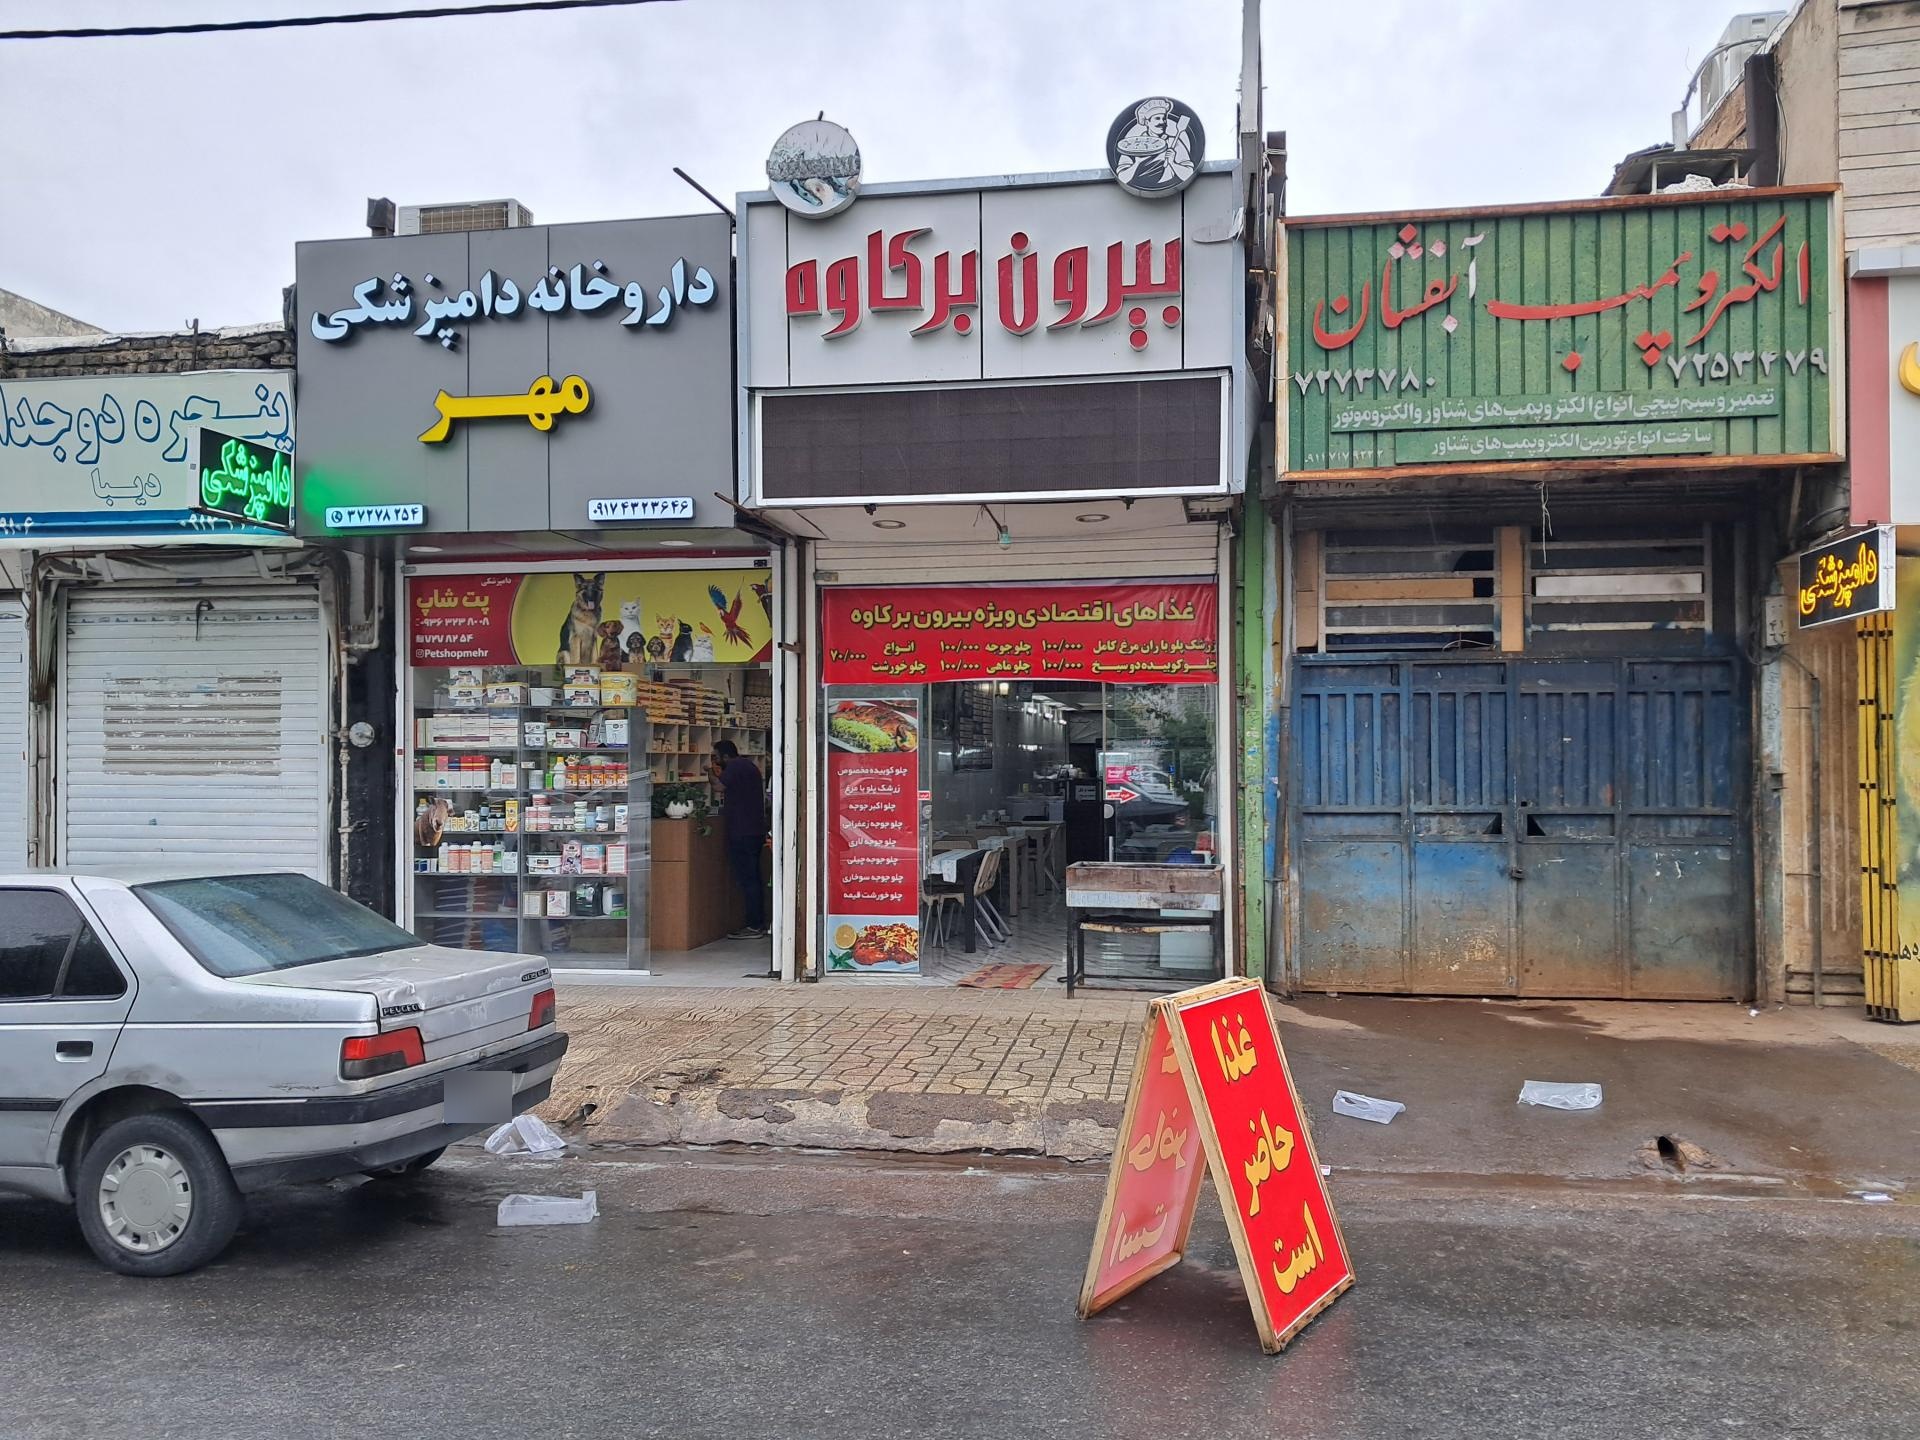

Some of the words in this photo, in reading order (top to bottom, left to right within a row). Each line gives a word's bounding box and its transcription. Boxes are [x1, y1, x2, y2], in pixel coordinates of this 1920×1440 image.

[529, 257, 718, 327] داروخانه
[997, 231, 1182, 351] بیرون
[311, 269, 526, 352] دامپزشکی
[1666, 347, 1829, 380] ۷۲۵۳۴۷۹
[1294, 366, 1436, 396] ۷۲۷۳۷۸۰
[417, 375, 593, 443] مهر
[1424, 398, 1467, 424] شناور
[1594, 394, 1633, 418] انواع
[1729, 388, 1775, 412] تعمیر
[1432, 435, 1470, 455] شناور
[1581, 431, 1627, 452] توربین
[1628, 430, 1661, 452] انواع
[1663, 426, 1711, 443] ساخت
[91, 467, 162, 506] دیبا
[416, 588, 459, 617] شاپ
[462, 591, 490, 615] پت
[1018, 600, 1112, 628] اقتصادی
[1114, 597, 1195, 627] غذاهای
[850, 605, 892, 629] کاوه
[913, 608, 972, 630] بیرون
[974, 602, 1016, 629] ویژه
[424, 648, 489, 660] Petshopmehr
[883, 641, 915, 655] انواع
[985, 642, 1013, 655] جوجه
[1014, 641, 1032, 655] چلو
[1093, 639, 1117, 654] کامل
[1119, 640, 1139, 654] مرغ
[1170, 639, 1184, 654] پلو
[871, 660, 908, 674] خورشت
[910, 660, 927, 674] چلو
[986, 660, 1013, 674] ماهی
[1013, 660, 1031, 674] چلو
[1091, 660, 1129, 673] سیخ
[383, 1003, 419, 1016] PEUGEO
[1210, 1014, 1256, 1084] غذا
[1243, 1109, 1296, 1217] حاضر
[1272, 1200, 1326, 1294] است
